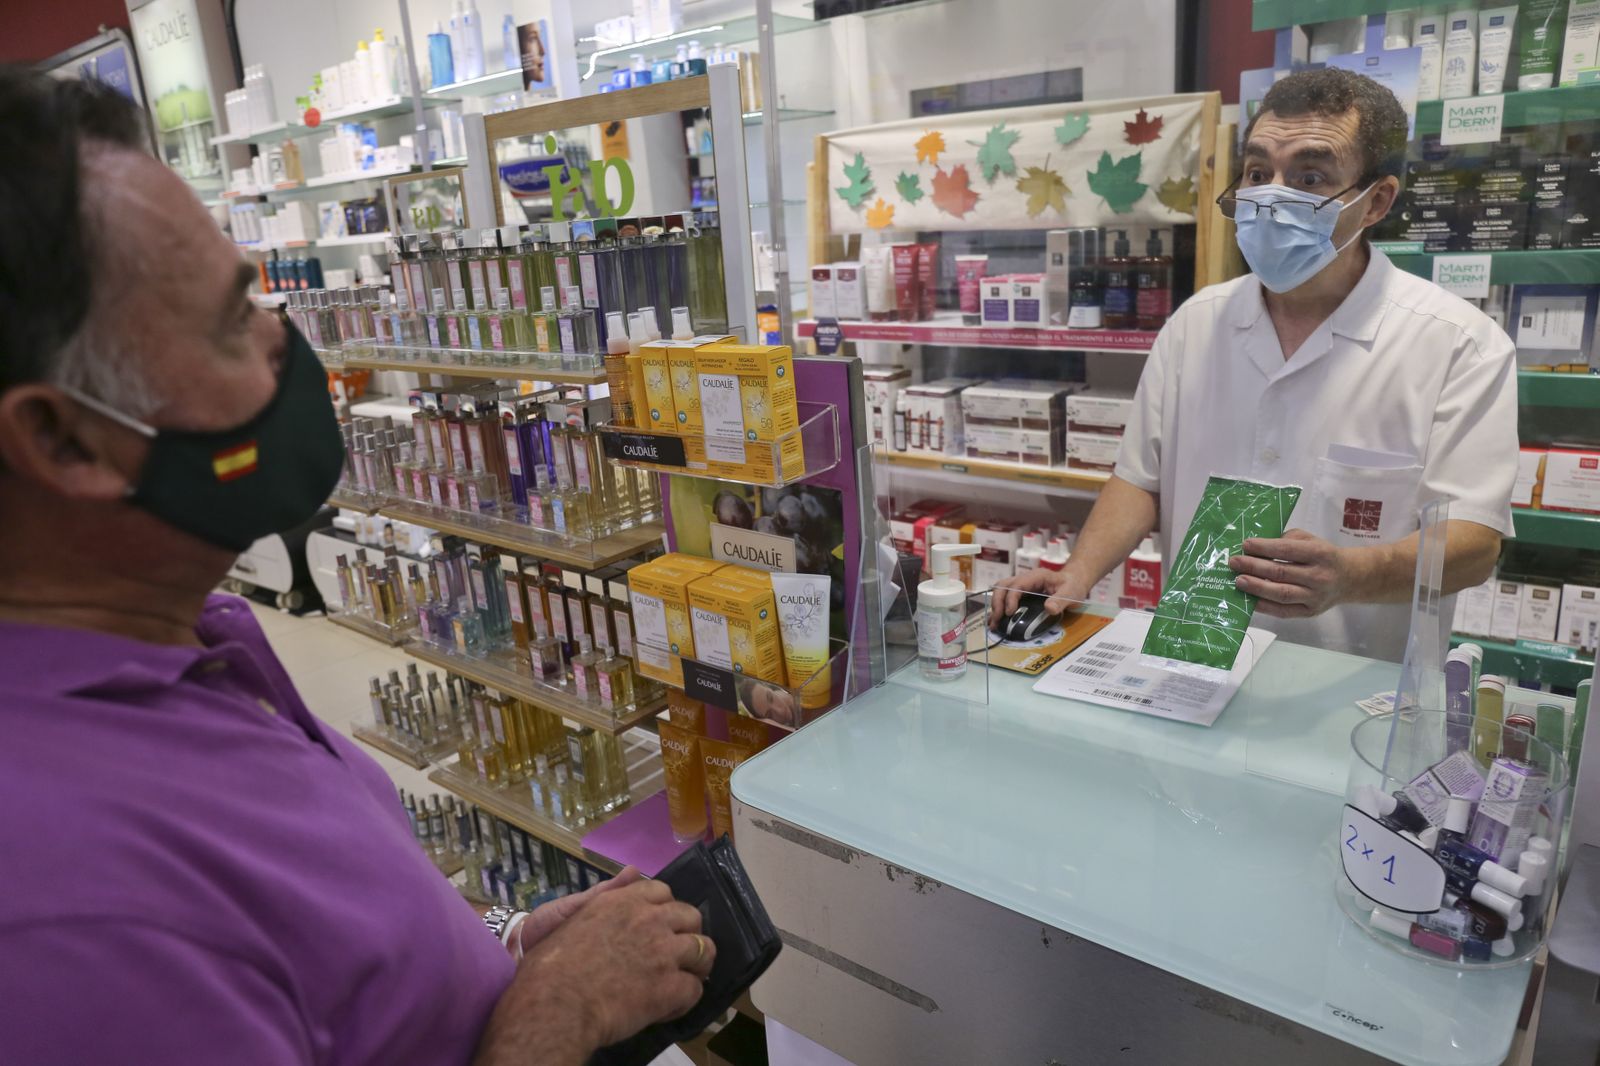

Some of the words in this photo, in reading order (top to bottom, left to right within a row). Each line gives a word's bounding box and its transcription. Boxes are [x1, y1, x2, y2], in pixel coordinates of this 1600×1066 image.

[1449, 106, 1496, 117] MARTI
[1440, 264, 1484, 272] MARTI
[817, 326, 838, 334] NUEVO
[1205, 582, 1224, 590] cuida
